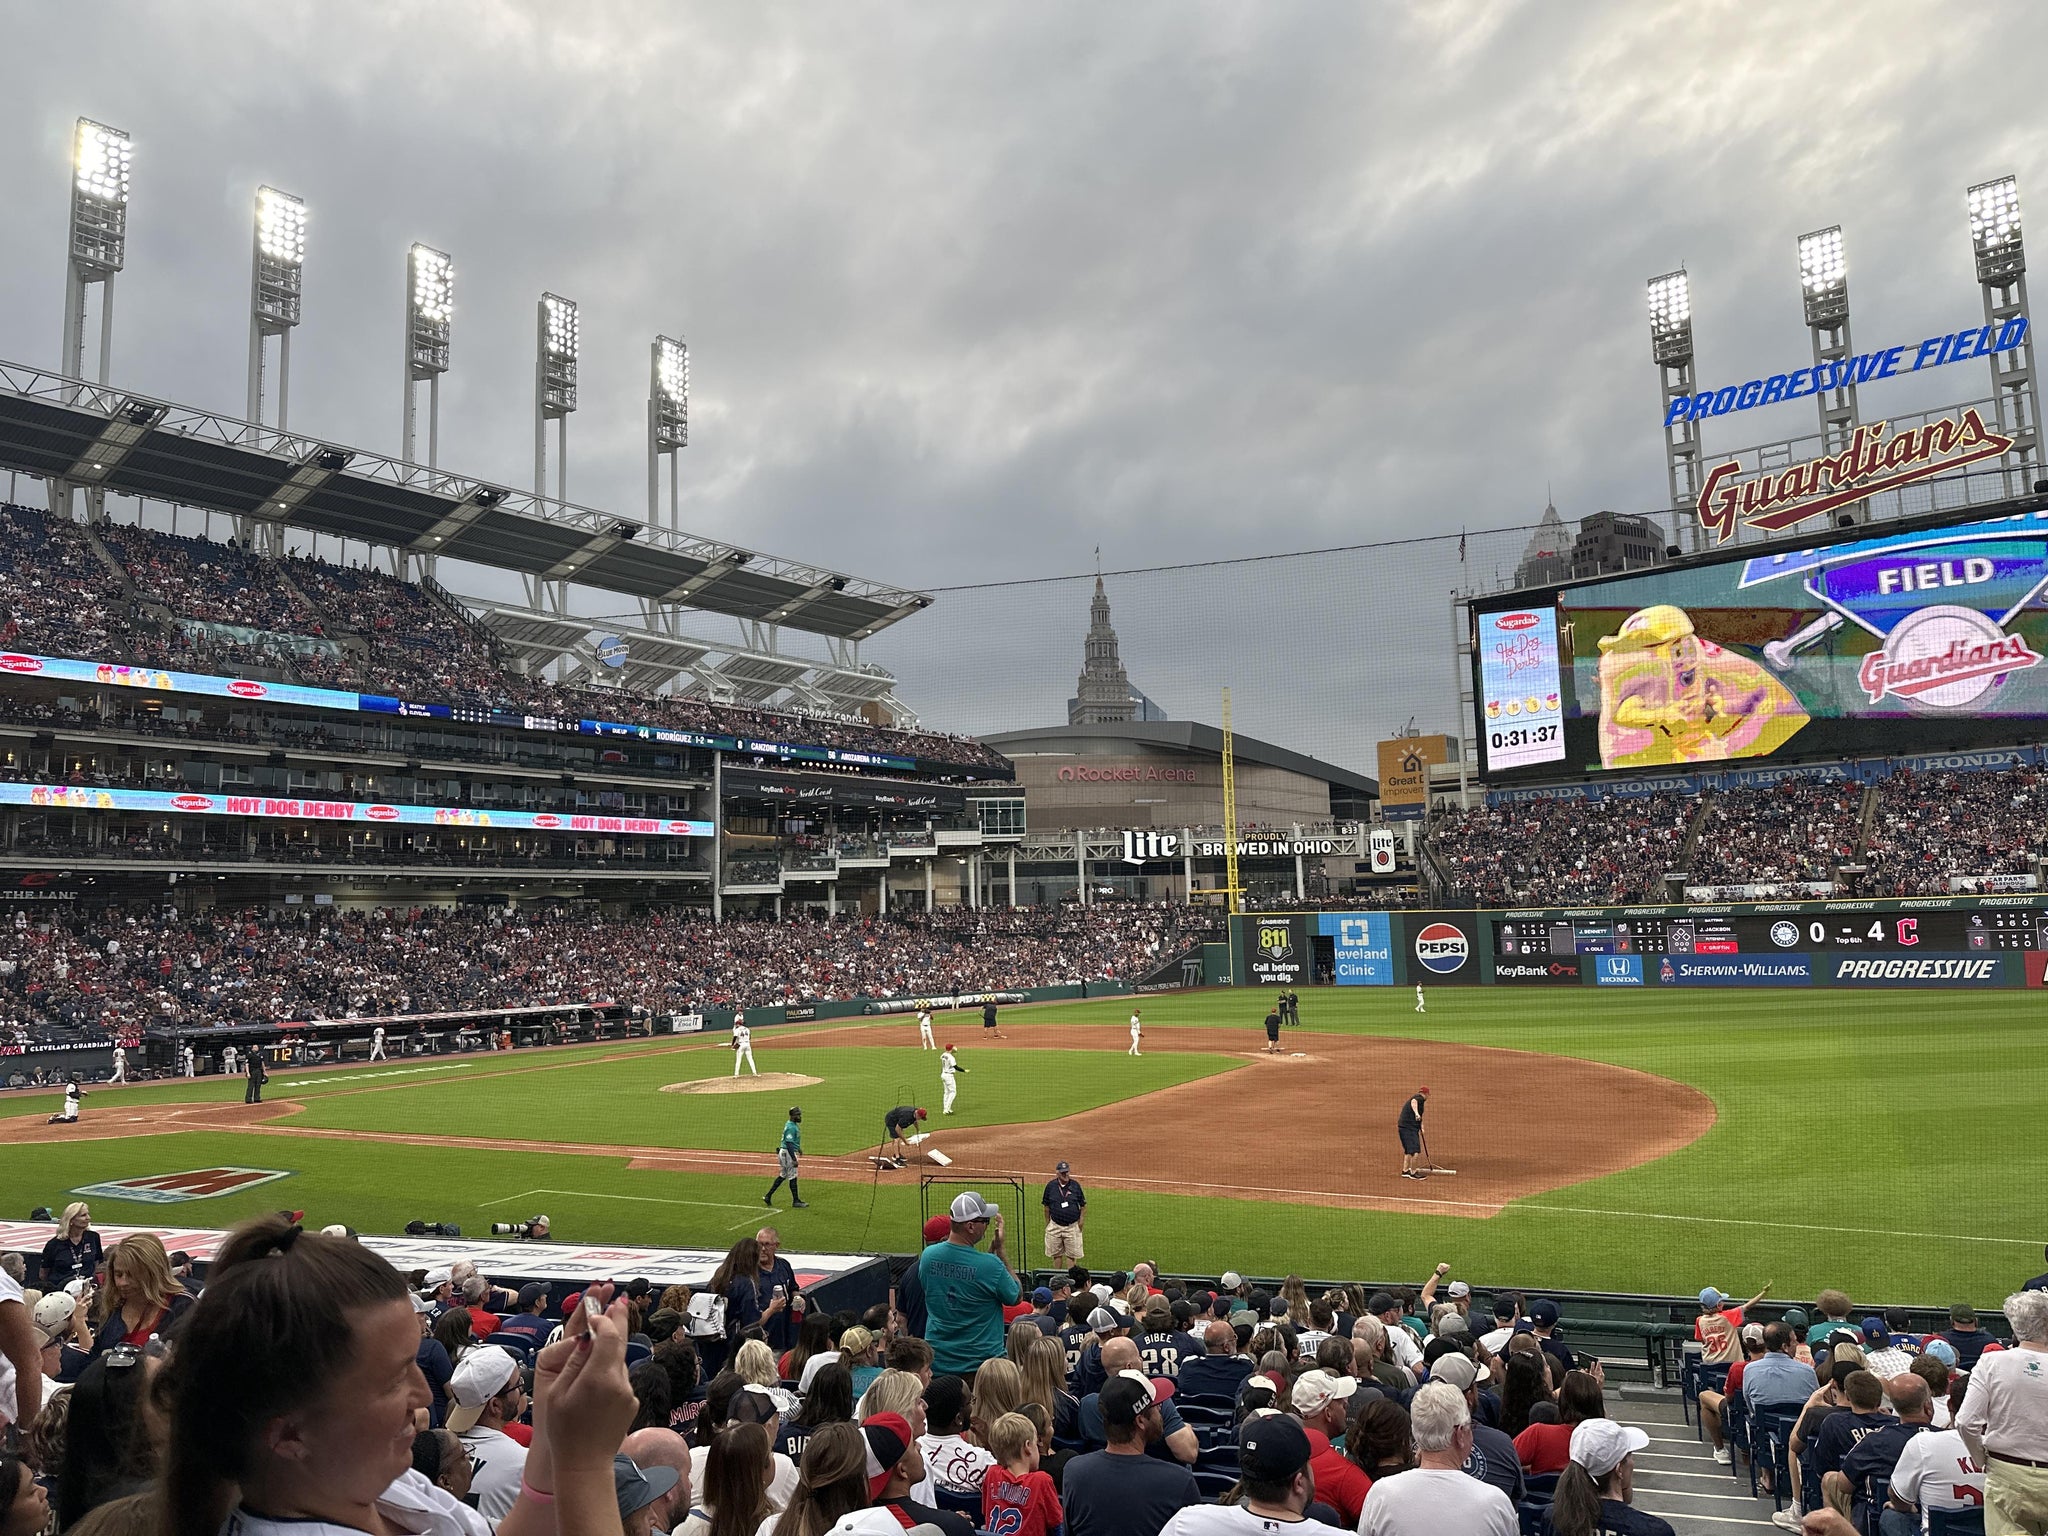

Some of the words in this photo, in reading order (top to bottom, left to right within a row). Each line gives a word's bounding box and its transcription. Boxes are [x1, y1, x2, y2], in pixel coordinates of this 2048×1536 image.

[1664, 345, 1905, 428] PROGRESSIVE
[1912, 317, 2030, 371] FIELD
[1697, 408, 2014, 545] Guardians
[1878, 558, 1995, 595] FIELD
[1497, 615, 1540, 630] Sugardale
[1496, 641, 1518, 664] Hot
[1517, 633, 1543, 656] Dog
[1506, 650, 1543, 679] Derby
[1860, 634, 2042, 702] Guardians
[228, 683, 266, 695] Sugardale
[638, 730, 649, 739] 44
[656, 731, 692, 744] RODRÍGUEZ
[695, 736, 705, 744] 1-2
[1491, 725, 1558, 749] 0:31:37
[737, 740, 743, 749] 8
[751, 742, 777, 753] CANZONE
[780, 745, 788, 753] 1-2
[841, 752, 870, 764] AROZARENA
[1924, 752, 2026, 769] HONDA
[1077, 766, 1141, 781] Rocket
[1145, 766, 1196, 781] Arena
[1756, 766, 1846, 783] HONDA
[1389, 777, 1417, 787] Great
[1612, 779, 1692, 794] HONDA
[761, 785, 783, 794] KeyBank
[1513, 786, 1587, 801] HONDA
[876, 795, 895, 803] KeyBank
[172, 797, 213, 810] Sugardale
[226, 797, 262, 814] HOT
[265, 799, 301, 816] DOG
[303, 801, 355, 818] DERBY
[365, 807, 400, 819] Sugardale
[571, 816, 596, 830] HOT
[597, 818, 622, 831] DOG
[624, 819, 661, 832] DERBY
[1245, 832, 1287, 841] PROUDLY
[1372, 836, 1392, 850] Lite
[1121, 831, 1178, 865] Lite
[1273, 842, 1289, 855] IN
[1293, 840, 1332, 855] OHIO
[1755, 904, 1801, 912] PROGRESSIVE
[1825, 902, 1876, 910] PROGRESSIVE
[1900, 900, 1952, 908] PROGRESSIVE
[1978, 897, 2034, 906] PROGRESSIVE
[1505, 911, 1545, 919] PROGRESSIVE
[1563, 909, 1604, 918] PROGRESSIVE
[1624, 908, 1668, 916] PROGRESSIVE
[1687, 906, 1733, 914] PROGRESSIVE
[1260, 928, 1287, 948] 811
[1809, 922, 1825, 943] 0
[1867, 921, 1885, 942] 4
[1335, 948, 1388, 960] leveland
[1419, 943, 1465, 954] PEPSI
[1252, 963, 1269, 972] Call
[1271, 963, 1300, 972] before
[1339, 963, 1376, 977] Clinic
[1496, 965, 1548, 978] KeyBank
[1680, 963, 1806, 976] SHERWIN-WILLIAMS
[1837, 959, 1997, 979] PROGRESSIVE
[1260, 974, 1276, 983] you
[1277, 972, 1293, 983] dig.
[30, 1044, 71, 1053] CLEVELAND
[73, 1041, 112, 1049] GUARDIANS
[930, 1261, 978, 1281] EMERSON
[1144, 1333, 1173, 1345] BIBEE
[1706, 1335, 1729, 1352] 36
[1142, 1348, 1179, 1377] 28
[1132, 1393, 1152, 1415] CLE
[988, 1504, 1023, 1536] 12
